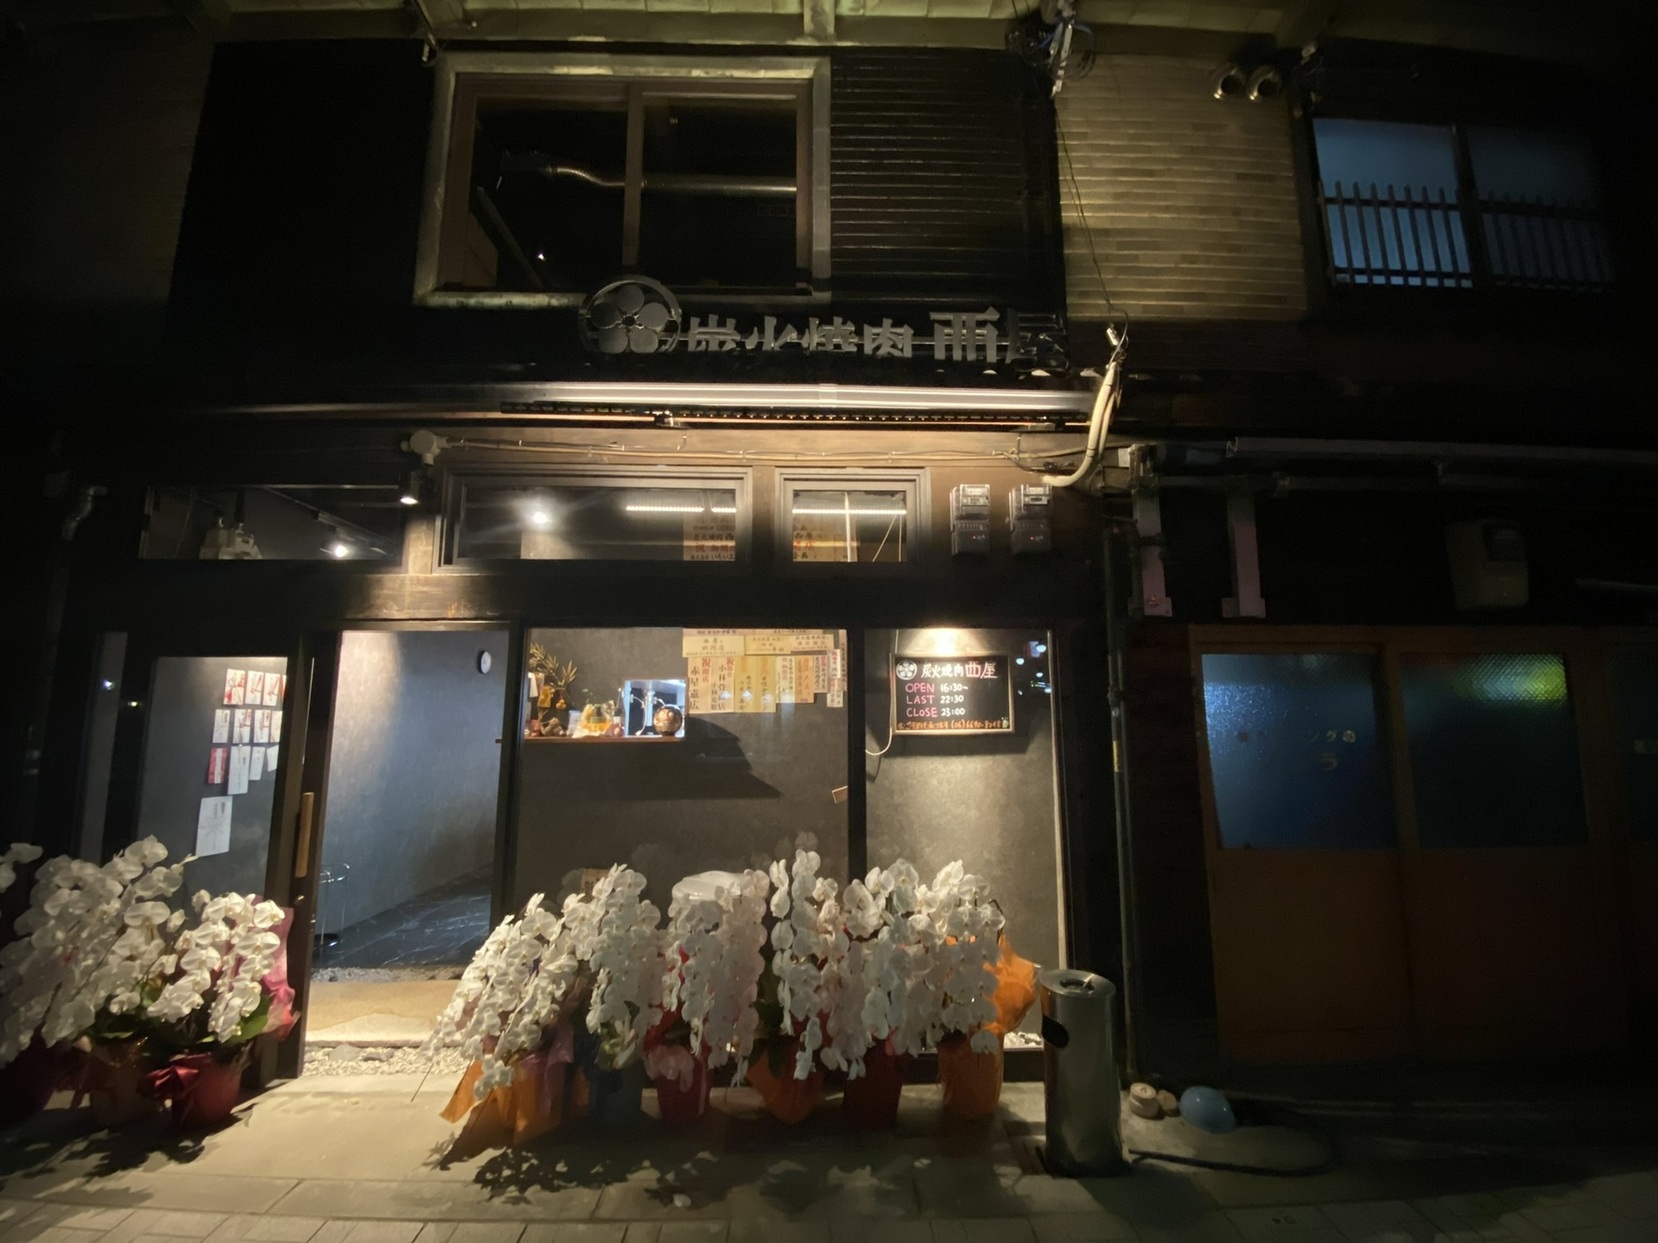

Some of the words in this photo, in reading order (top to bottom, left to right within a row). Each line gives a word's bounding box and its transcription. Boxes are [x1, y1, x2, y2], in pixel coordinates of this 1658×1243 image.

[905, 682, 935, 693] OPEN
[906, 695, 935, 705] LAST
[939, 694, 965, 704] 22:30
[940, 707, 966, 716] 23:00
